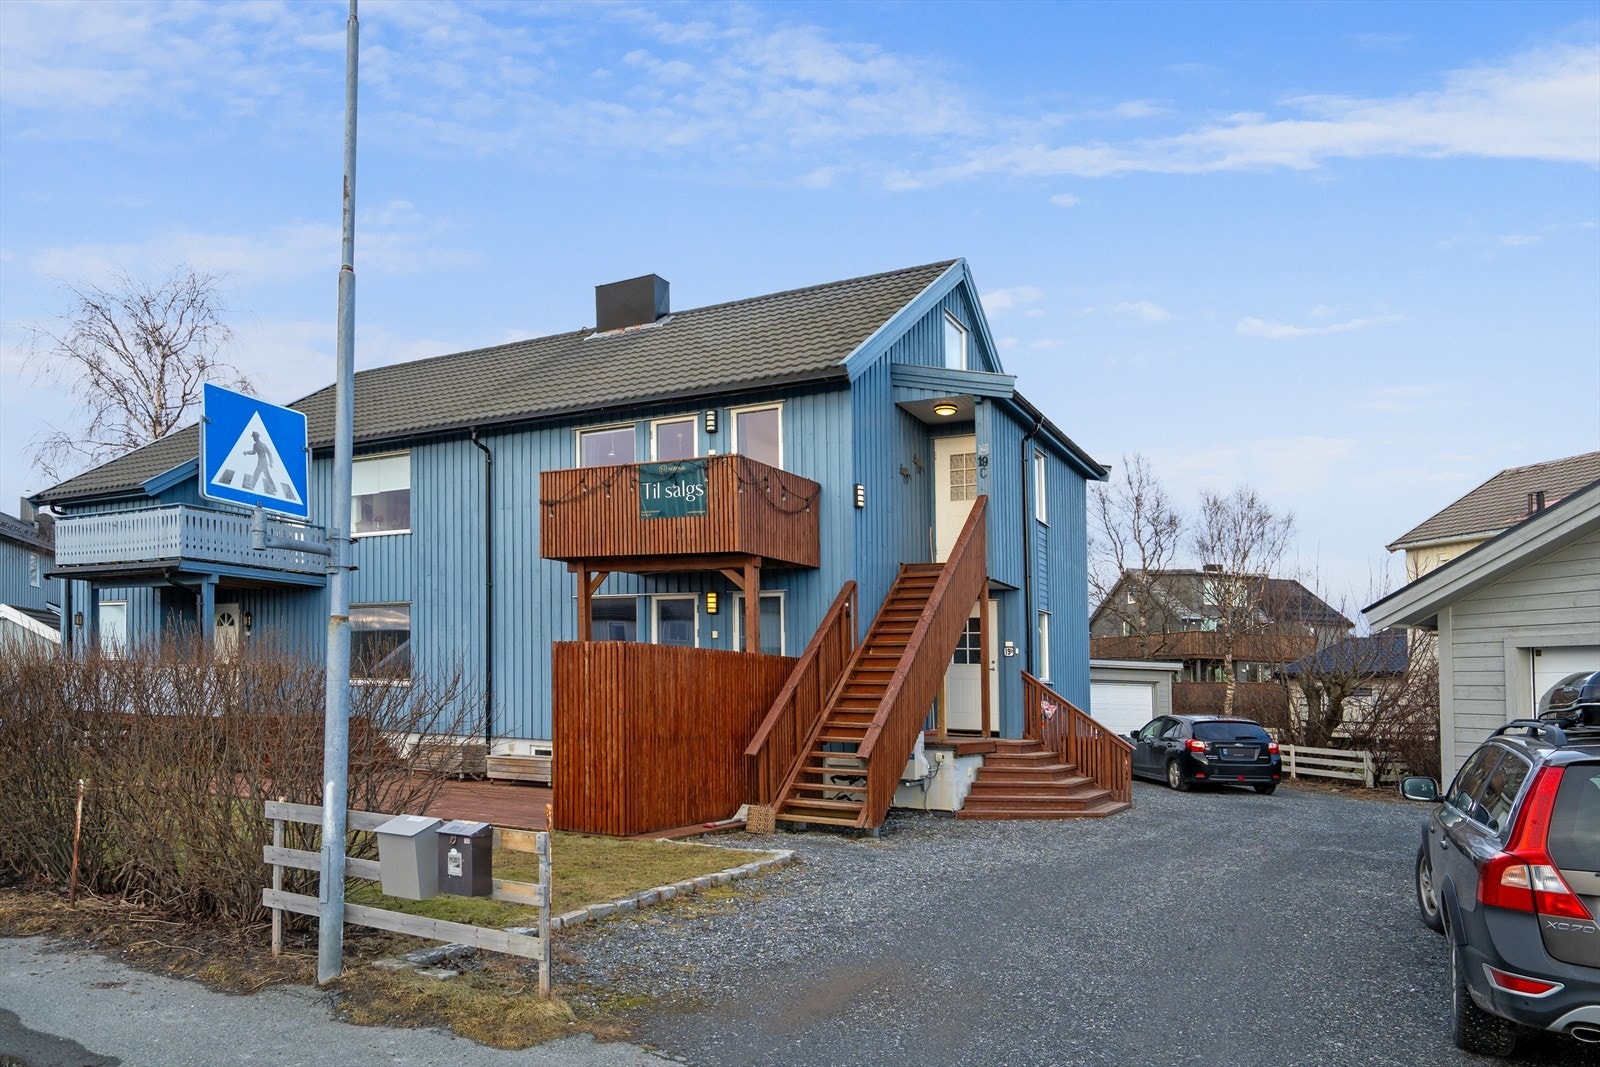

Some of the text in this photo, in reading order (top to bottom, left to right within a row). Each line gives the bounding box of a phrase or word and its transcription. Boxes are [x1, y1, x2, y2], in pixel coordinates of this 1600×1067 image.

[977, 455, 989, 467] 19
[979, 467, 987, 479] C
[642, 480, 704, 502] Til salgs
[1546, 920, 1595, 934] XC70
